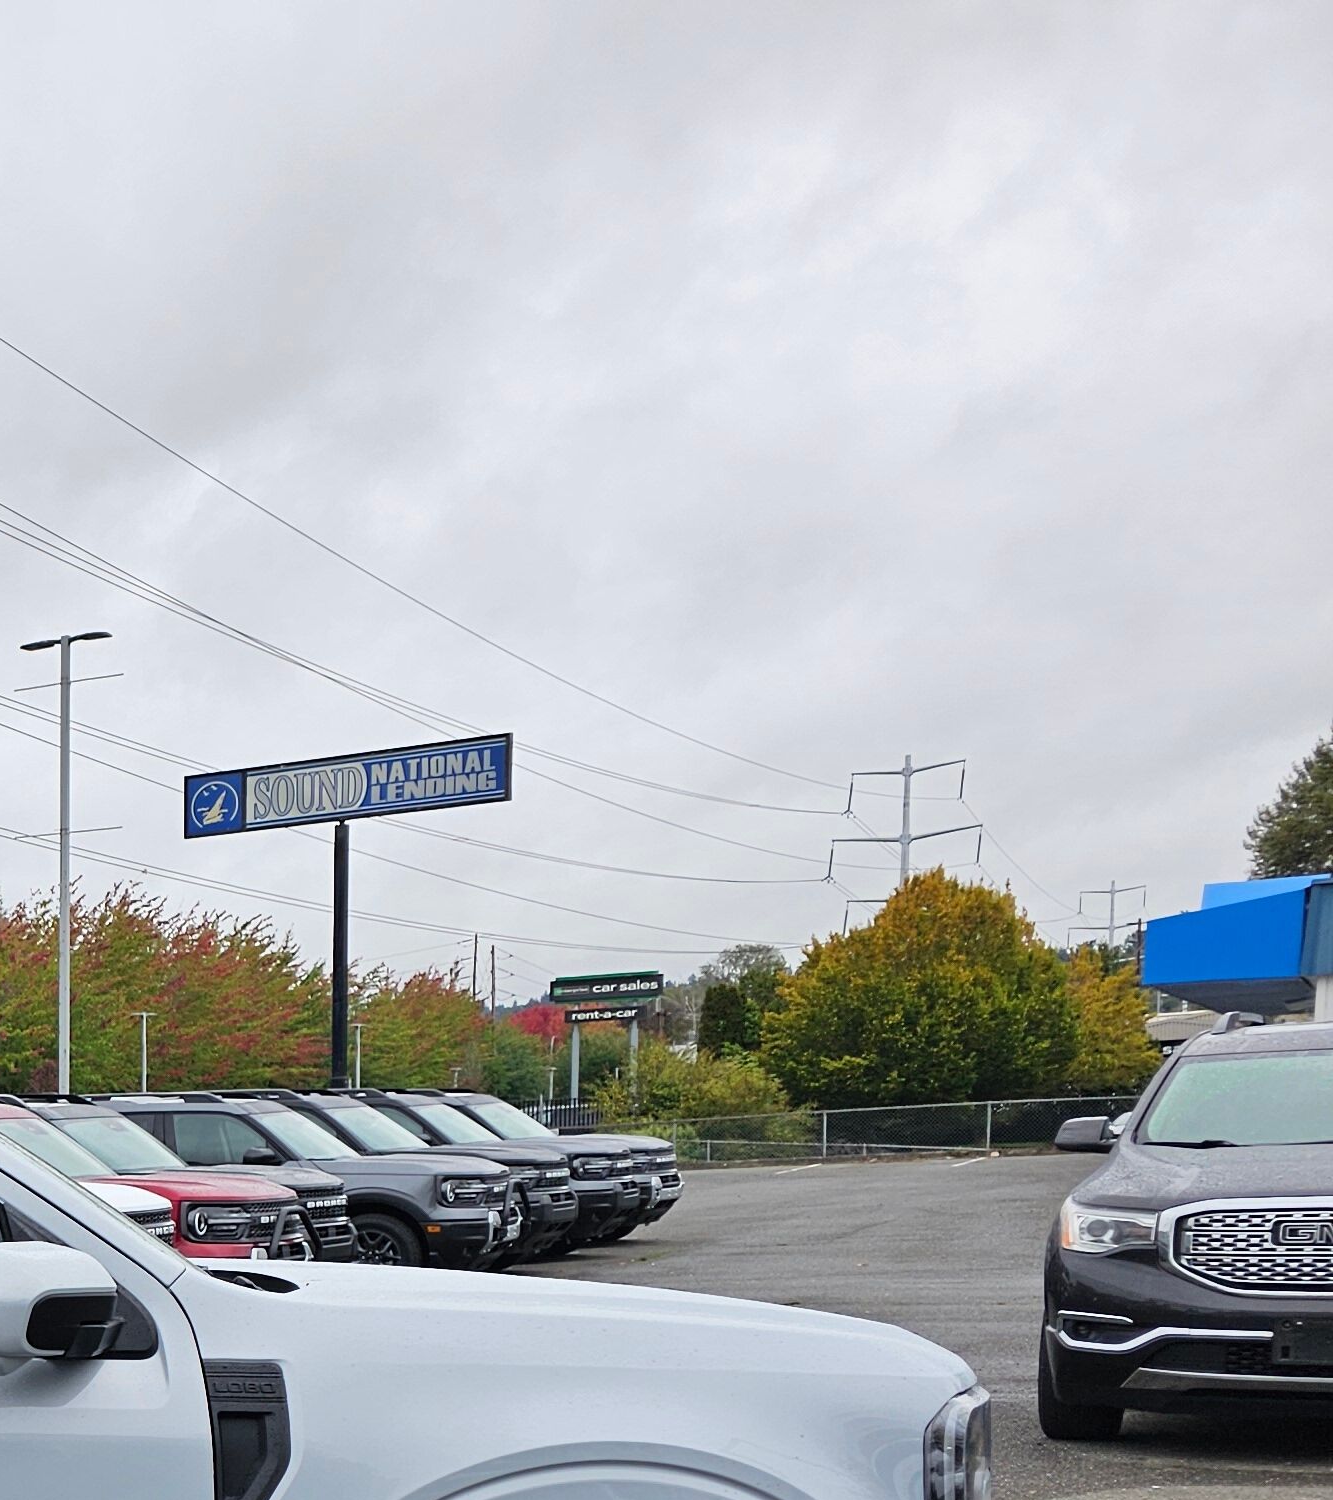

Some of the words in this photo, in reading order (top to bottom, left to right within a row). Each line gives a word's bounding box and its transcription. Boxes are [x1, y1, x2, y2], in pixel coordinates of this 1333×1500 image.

[371, 749, 496, 785] NATIONAL
[253, 768, 363, 820] SOUND
[371, 770, 497, 804] LENDING
[592, 983, 617, 993] car
[619, 979, 658, 991] sales
[571, 1009, 638, 1020] rent-a-car
[213, 1382, 277, 1394] LOBO
